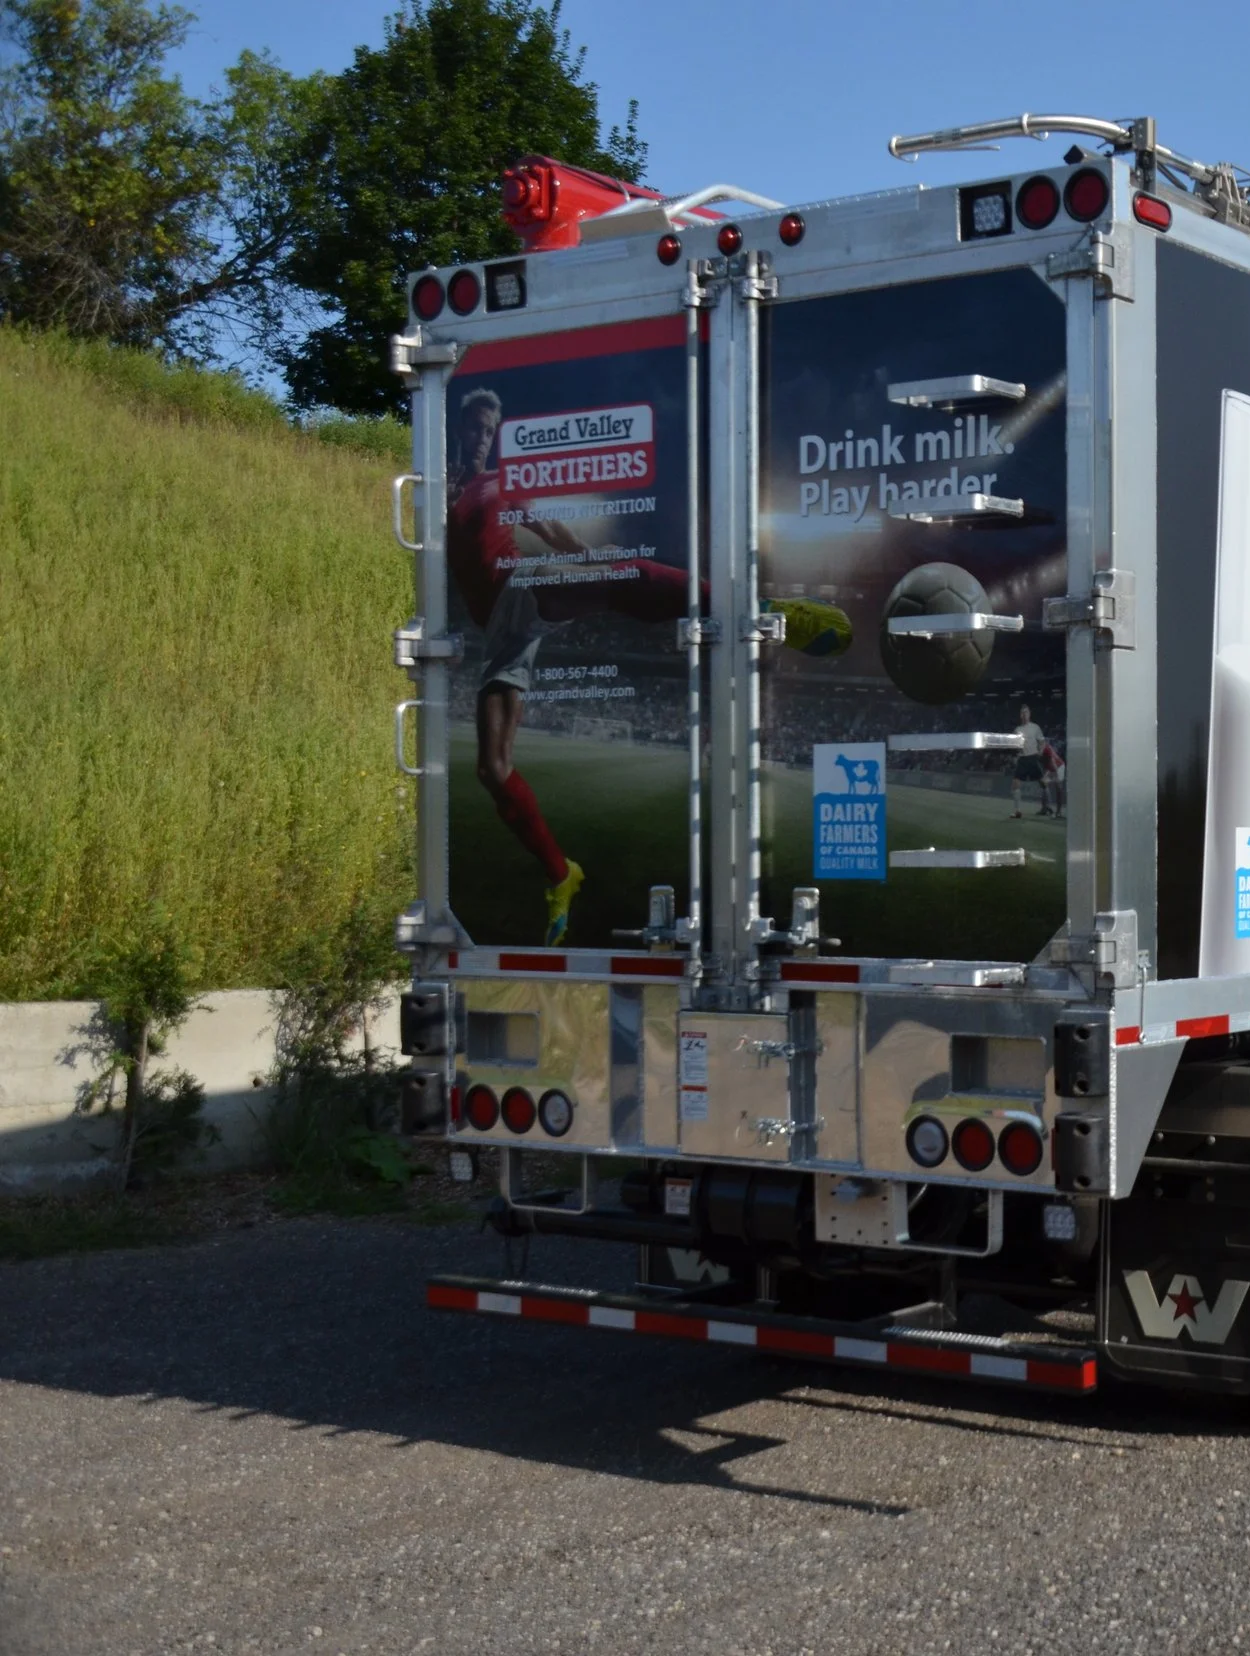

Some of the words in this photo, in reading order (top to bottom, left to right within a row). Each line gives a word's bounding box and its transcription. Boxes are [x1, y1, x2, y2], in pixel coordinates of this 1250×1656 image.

[515, 420, 570, 446] Grand
[575, 415, 634, 440] Valley
[799, 424, 906, 474] Drink
[915, 414, 1015, 463] milk.
[505, 450, 648, 491] FORTIFIERS
[800, 478, 871, 524] Play
[879, 466, 997, 509] harder
[498, 510, 524, 526] FOR
[527, 504, 575, 523] SOUND
[580, 497, 657, 518] NUTRITION
[496, 552, 548, 569] Advanced
[550, 549, 588, 566] Animal
[589, 547, 637, 562] Nutrition
[640, 545, 656, 558] for
[510, 572, 560, 588] Improved
[562, 569, 602, 584] Human
[604, 566, 640, 581] Health
[519, 685, 635, 703] www.grandvalley.com
[820, 803, 879, 822] DAIRY
[820, 824, 878, 843] FARMERS
[836, 846, 878, 855] CANADA
